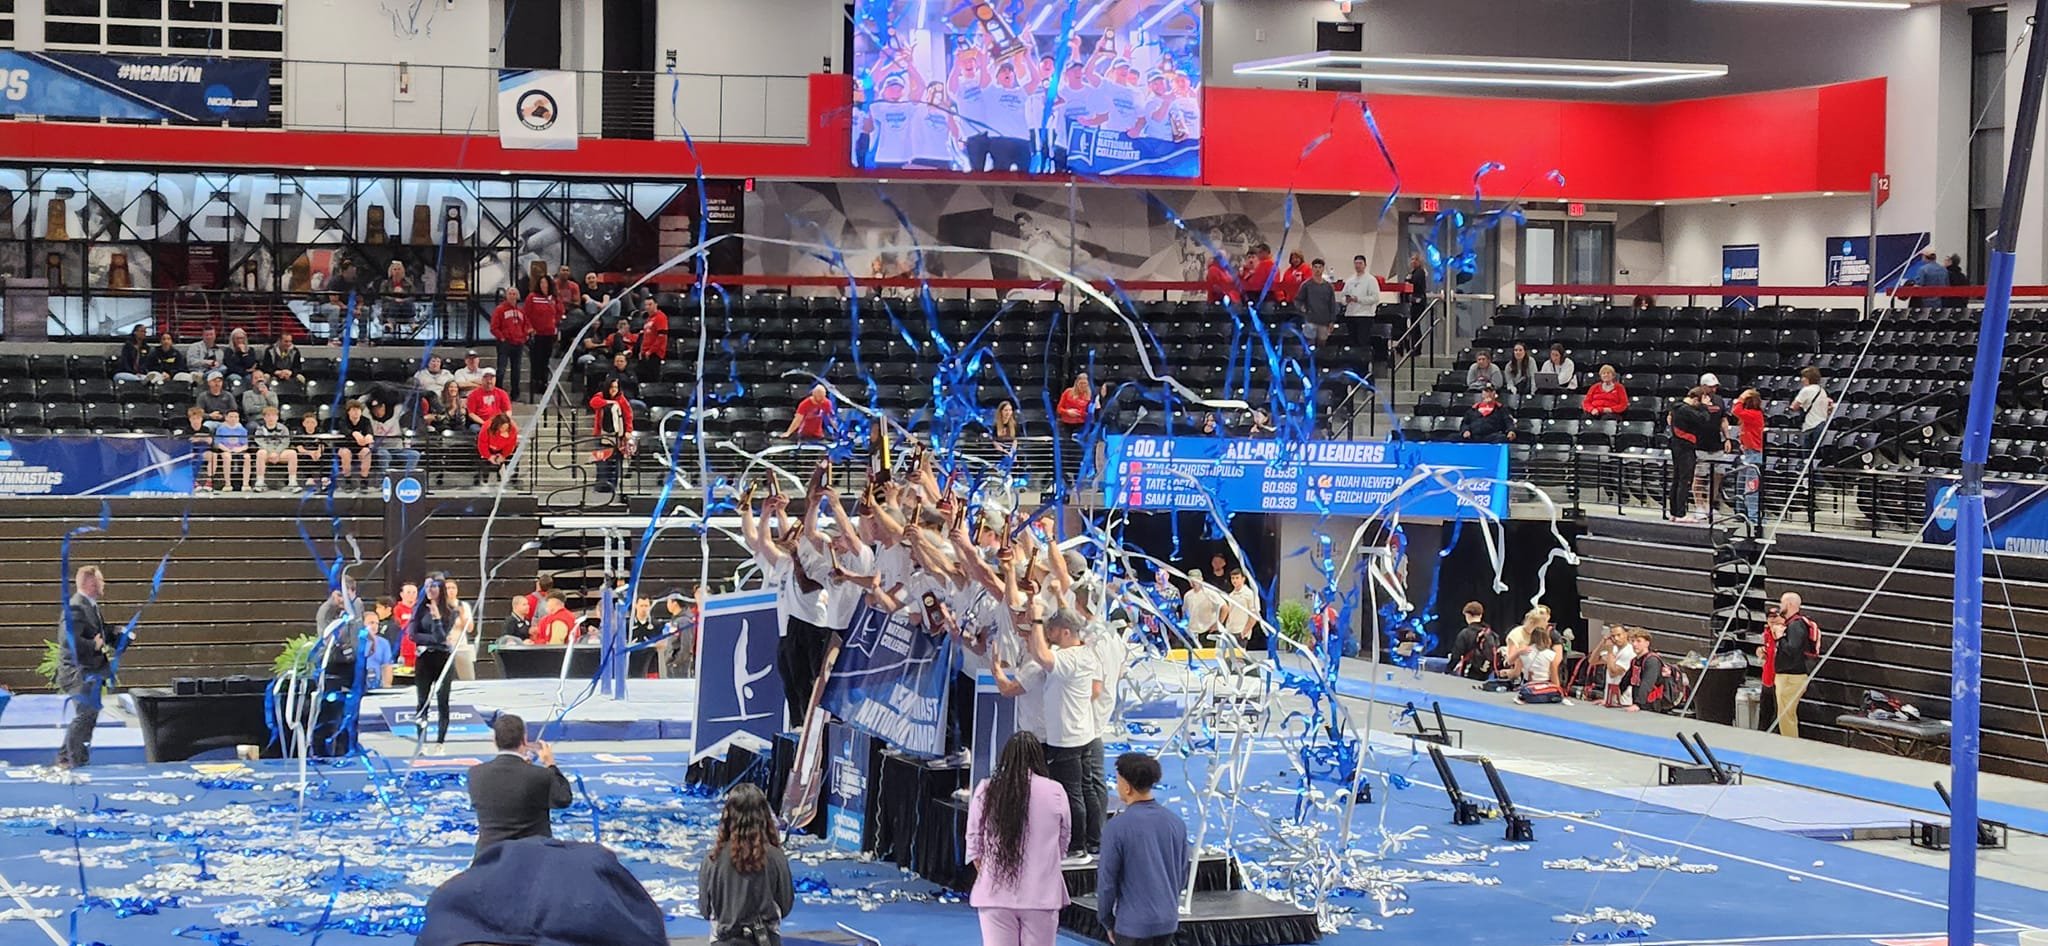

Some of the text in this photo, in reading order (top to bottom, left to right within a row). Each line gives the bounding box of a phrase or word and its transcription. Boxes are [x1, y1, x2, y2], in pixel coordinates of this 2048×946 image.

[117, 65, 202, 83] #NCAAGYM
[1879, 178, 1888, 190] 12
[119, 171, 479, 245] DEFEND
[1317, 443, 1386, 463] LEADERS
[1145, 478, 1169, 491] TATE
[1334, 475, 1360, 488] NOAH
[1144, 493, 1167, 506] SAM
[1334, 490, 1363, 504] ERICH
